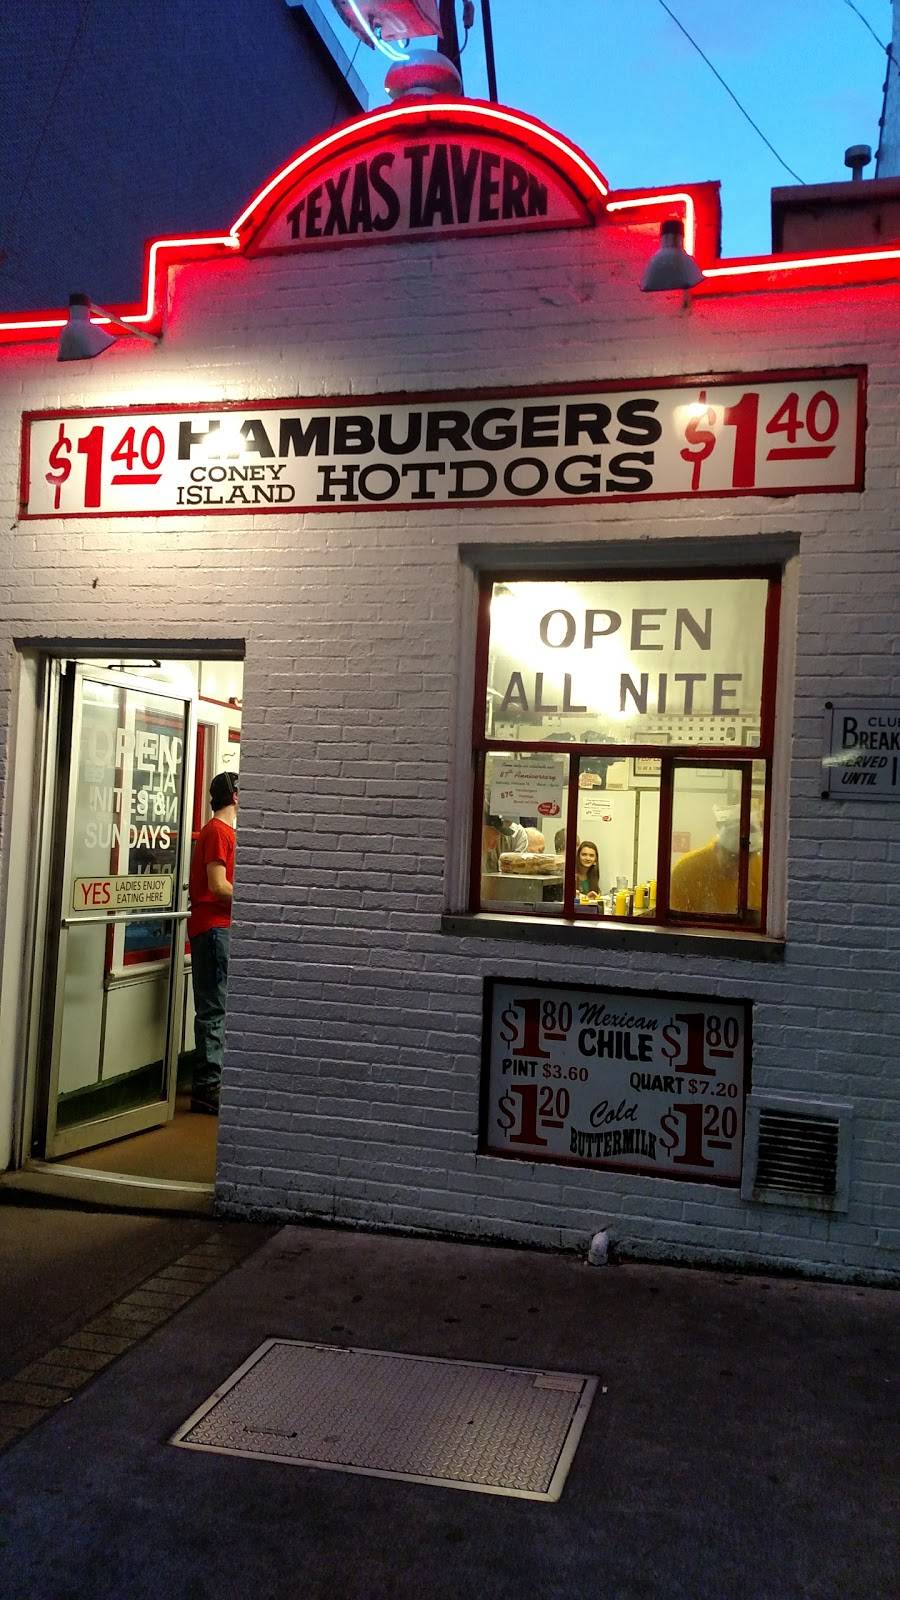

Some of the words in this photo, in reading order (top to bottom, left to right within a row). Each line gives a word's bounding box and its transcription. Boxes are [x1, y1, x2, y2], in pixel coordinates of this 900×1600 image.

[287, 152, 400, 239] TEXAS
[404, 144, 548, 228] TAVERN
[178, 398, 662, 460] HAMBURGERS
[189, 464, 288, 483] CONEY
[316, 451, 655, 502] HOTDOGS
[176, 484, 296, 506] ISLAND
[539, 608, 713, 651] OPEN
[501, 671, 588, 713] ALL
[620, 673, 743, 716] NITE
[841, 772, 877, 786] UNTIL
[83, 823, 171, 850] SUNDAYS
[81, 882, 111, 905] YES
[115, 881, 141, 891] LADIES
[143, 880, 166, 890] ENJOY
[117, 893, 144, 904] EATING
[145, 892, 163, 902] HERE
[578, 1002, 658, 1031] Mexican
[578, 1028, 653, 1062] CHILE
[502, 1058, 539, 1077] PINT
[542, 1063, 588, 1082] $3.60
[630, 1072, 684, 1094] QUART
[688, 1079, 738, 1099] $7.20
[589, 1100, 639, 1128] Cold
[569, 1126, 656, 1161] BUTTERMILK
